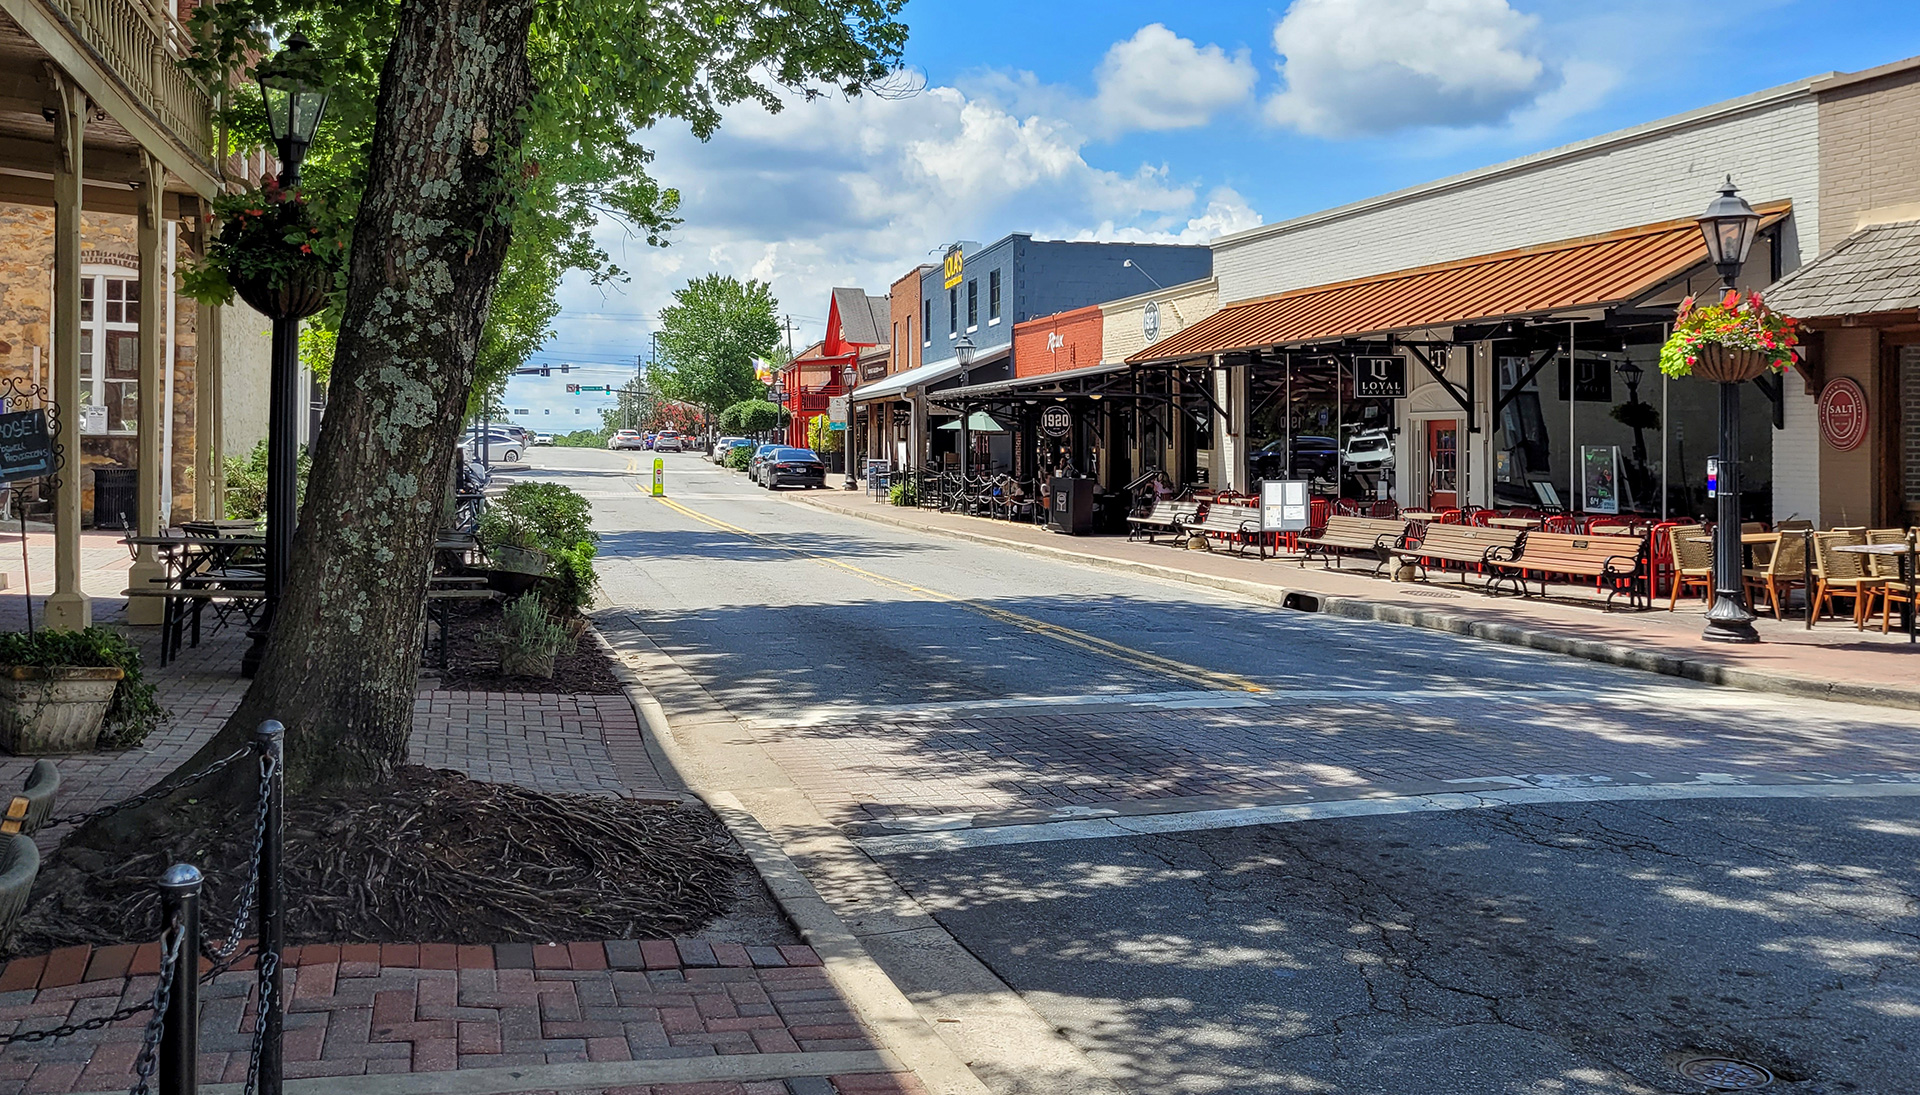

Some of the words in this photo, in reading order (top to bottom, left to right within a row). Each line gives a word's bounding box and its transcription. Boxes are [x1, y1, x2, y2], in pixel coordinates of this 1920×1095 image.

[1370, 359, 1393, 381] LT
[1362, 381, 1401, 390] LOYAL
[1829, 404, 1854, 414] SALT
[1044, 413, 1069, 427] 1920
